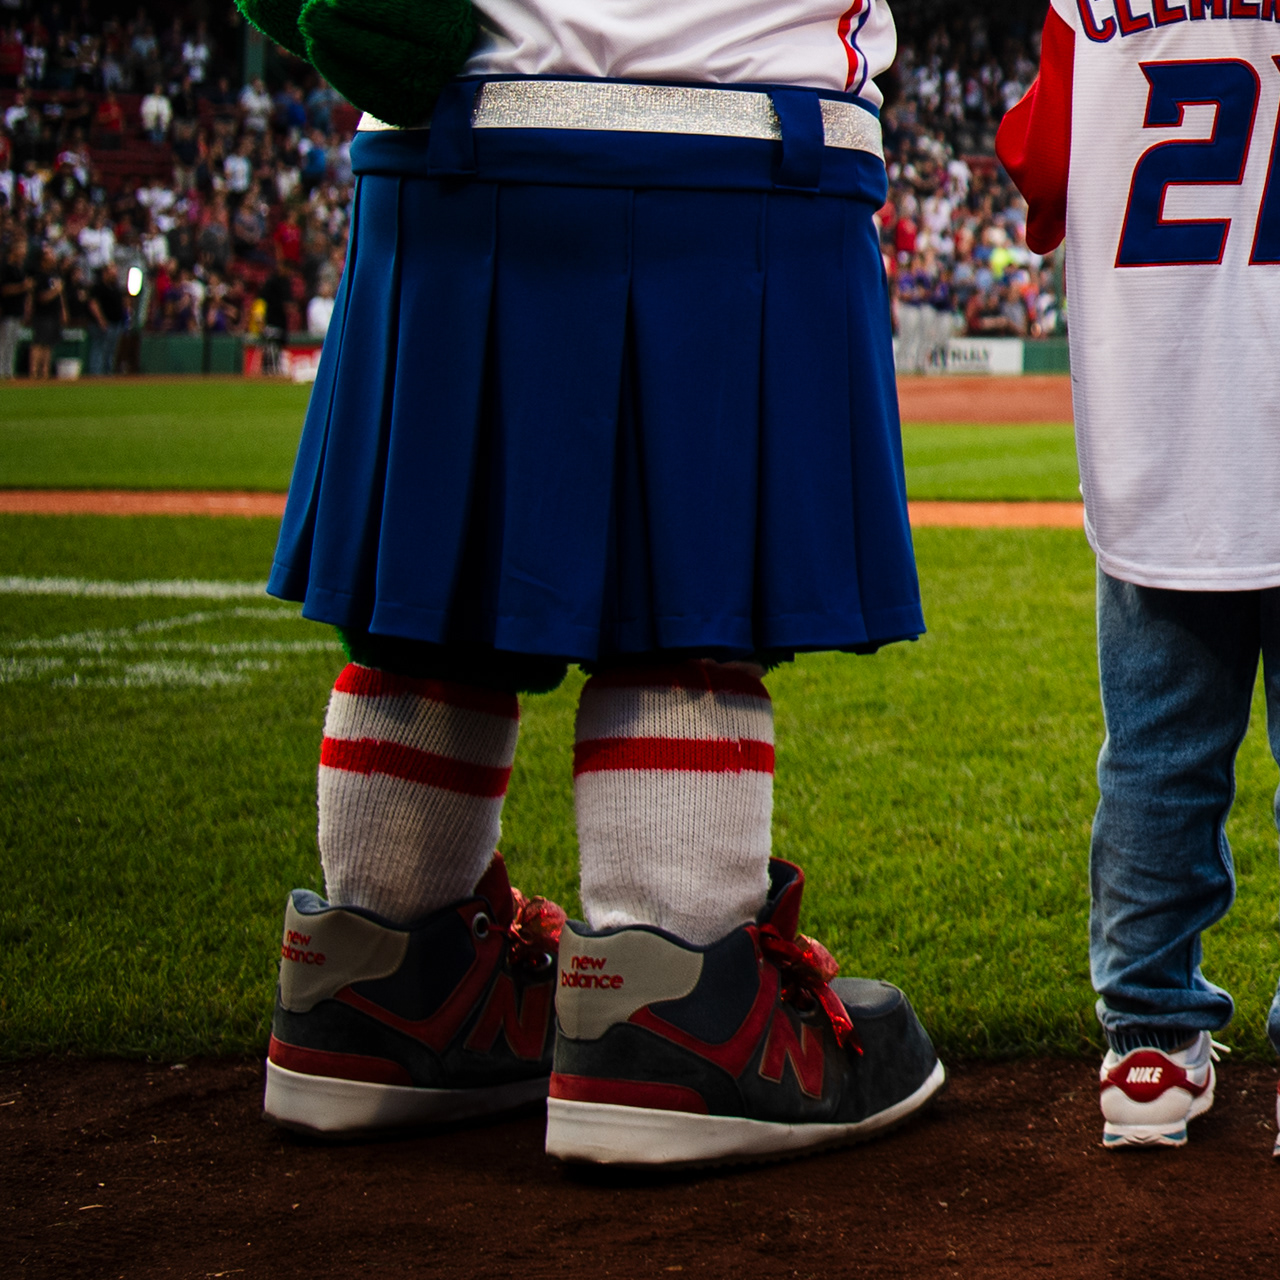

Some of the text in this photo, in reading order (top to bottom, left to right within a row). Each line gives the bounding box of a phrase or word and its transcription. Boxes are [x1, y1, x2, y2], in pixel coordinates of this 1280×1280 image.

[286, 929, 313, 947] new
[570, 954, 607, 971] new
[561, 970, 624, 990] balance
[1125, 1065, 1164, 1084] NIKE
